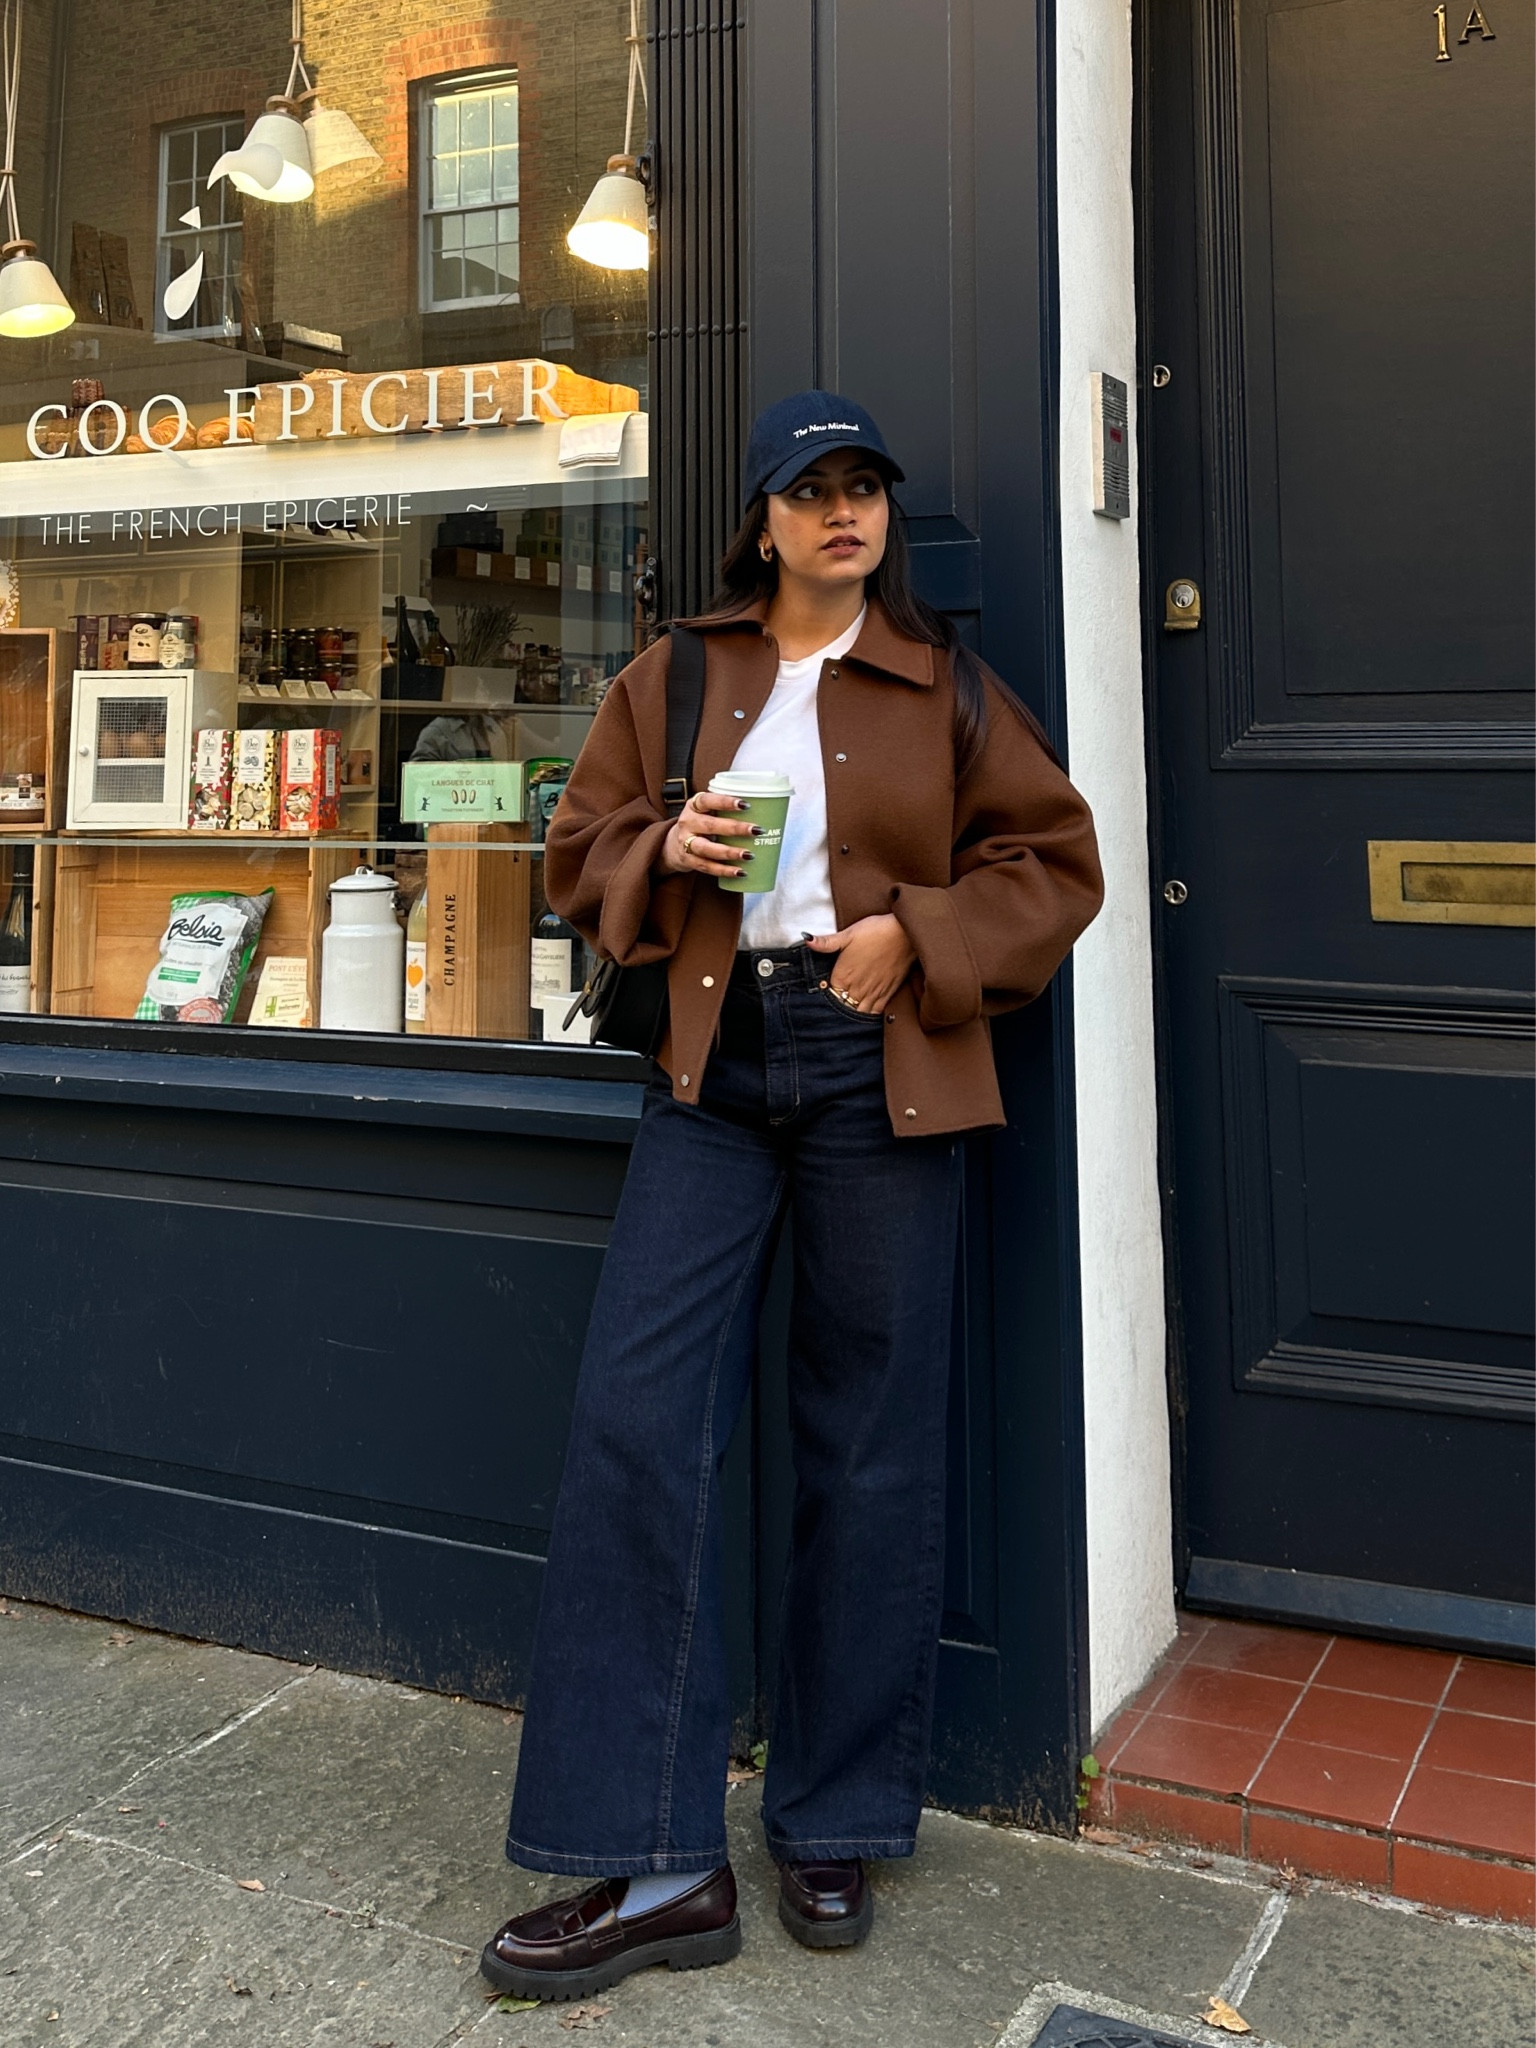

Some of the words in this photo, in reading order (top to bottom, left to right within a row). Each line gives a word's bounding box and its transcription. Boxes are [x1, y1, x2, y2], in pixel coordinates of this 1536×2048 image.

[1433, 0, 1496, 62] 1A
[26, 393, 192, 469] COQ
[222, 360, 570, 445] EPICIER
[793, 428, 807, 438] The
[828, 423, 859, 431] Minimal
[40, 514, 92, 545] THE
[112, 505, 241, 541] FRENCH
[263, 494, 412, 533] EPICERIE
[754, 837, 781, 845] STREET
[444, 893, 456, 987] CHAMPAGNE
